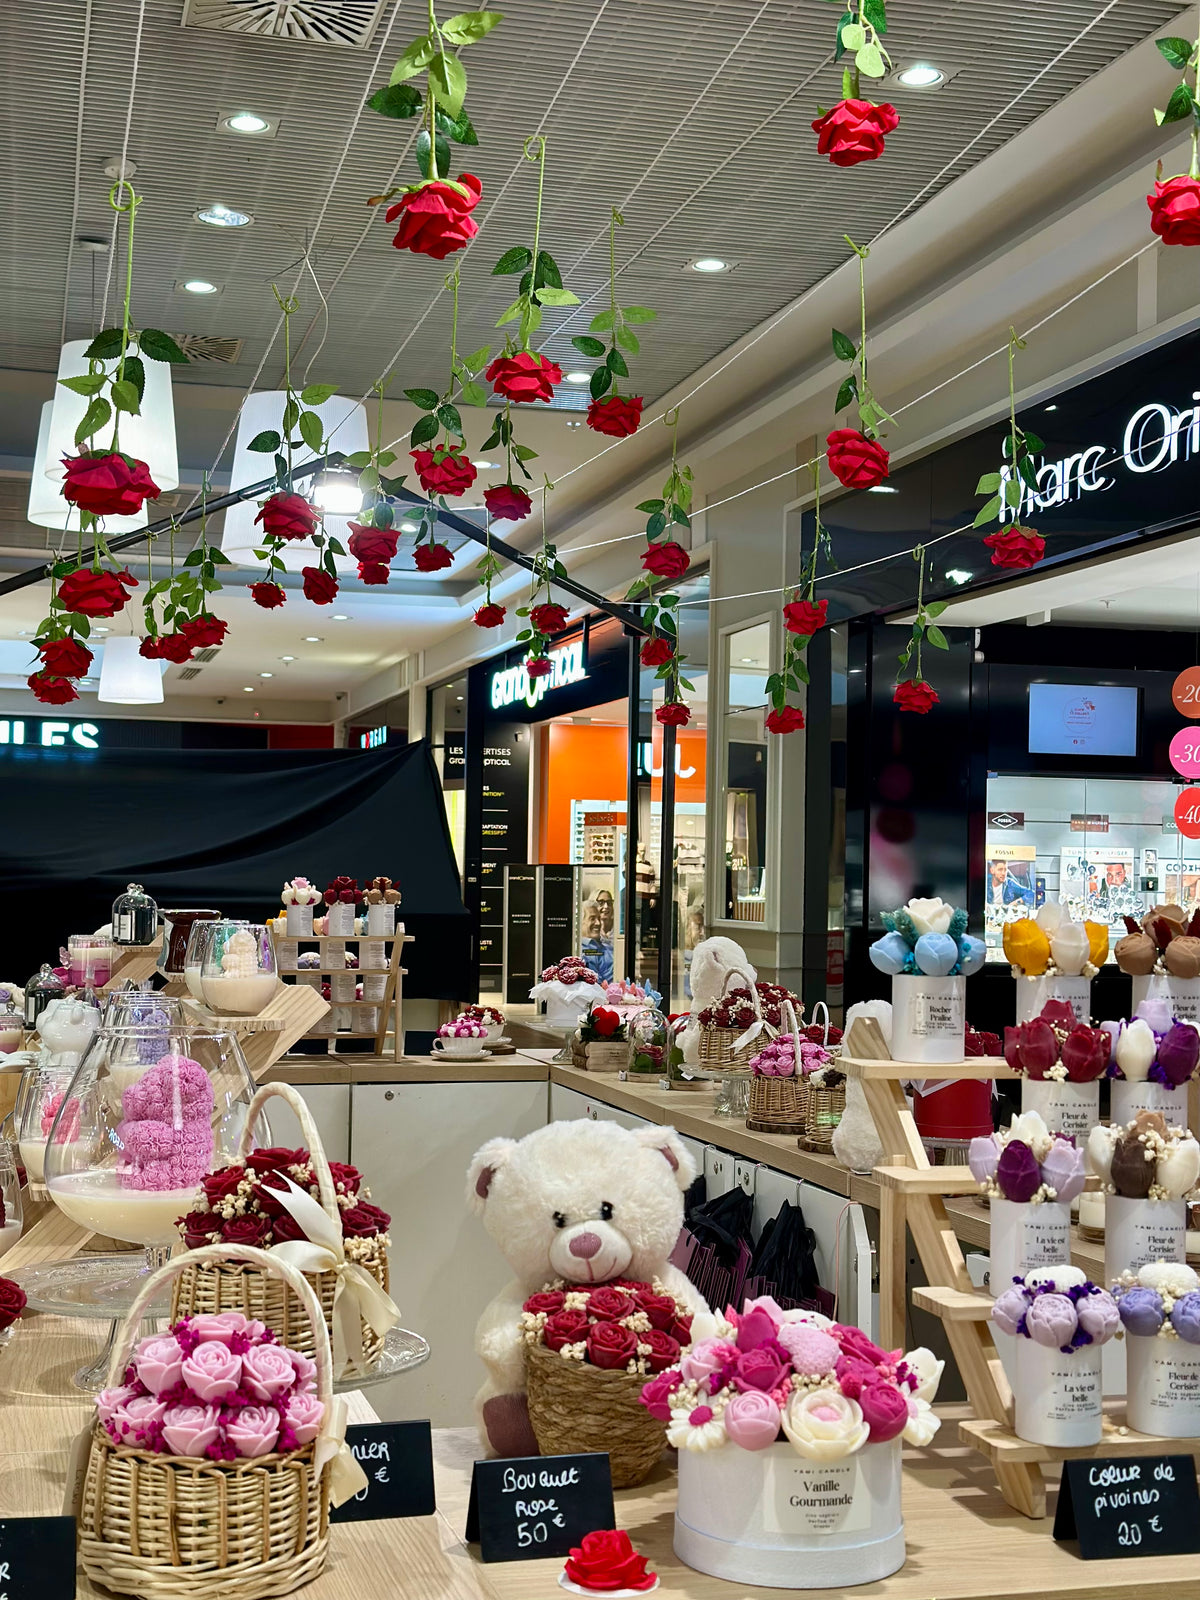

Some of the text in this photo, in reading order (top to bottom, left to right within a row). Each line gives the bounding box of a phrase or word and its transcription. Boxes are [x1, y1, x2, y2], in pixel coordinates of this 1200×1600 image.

[449, 747, 464, 755] LES
[929, 1005, 952, 1014] Rocher
[1172, 1003, 1190, 1011] Fleur
[1061, 1111, 1088, 1120] Fleur de
[1062, 1120, 1089, 1129] Cerisier
[1147, 1235, 1176, 1244] Fleur de
[1042, 1244, 1058, 1254] belle
[1148, 1244, 1176, 1253] Cerisier
[1168, 1371, 1199, 1381] Fleur de
[1064, 1383, 1096, 1393] La vie est
[1169, 1381, 1199, 1390] Cerisier
[1071, 1393, 1088, 1402] belle
[1153, 1463, 1176, 1482] de
[803, 1480, 840, 1492] Vanille
[789, 1493, 854, 1507] Gourmande
[1094, 1488, 1160, 1518] pivoines
